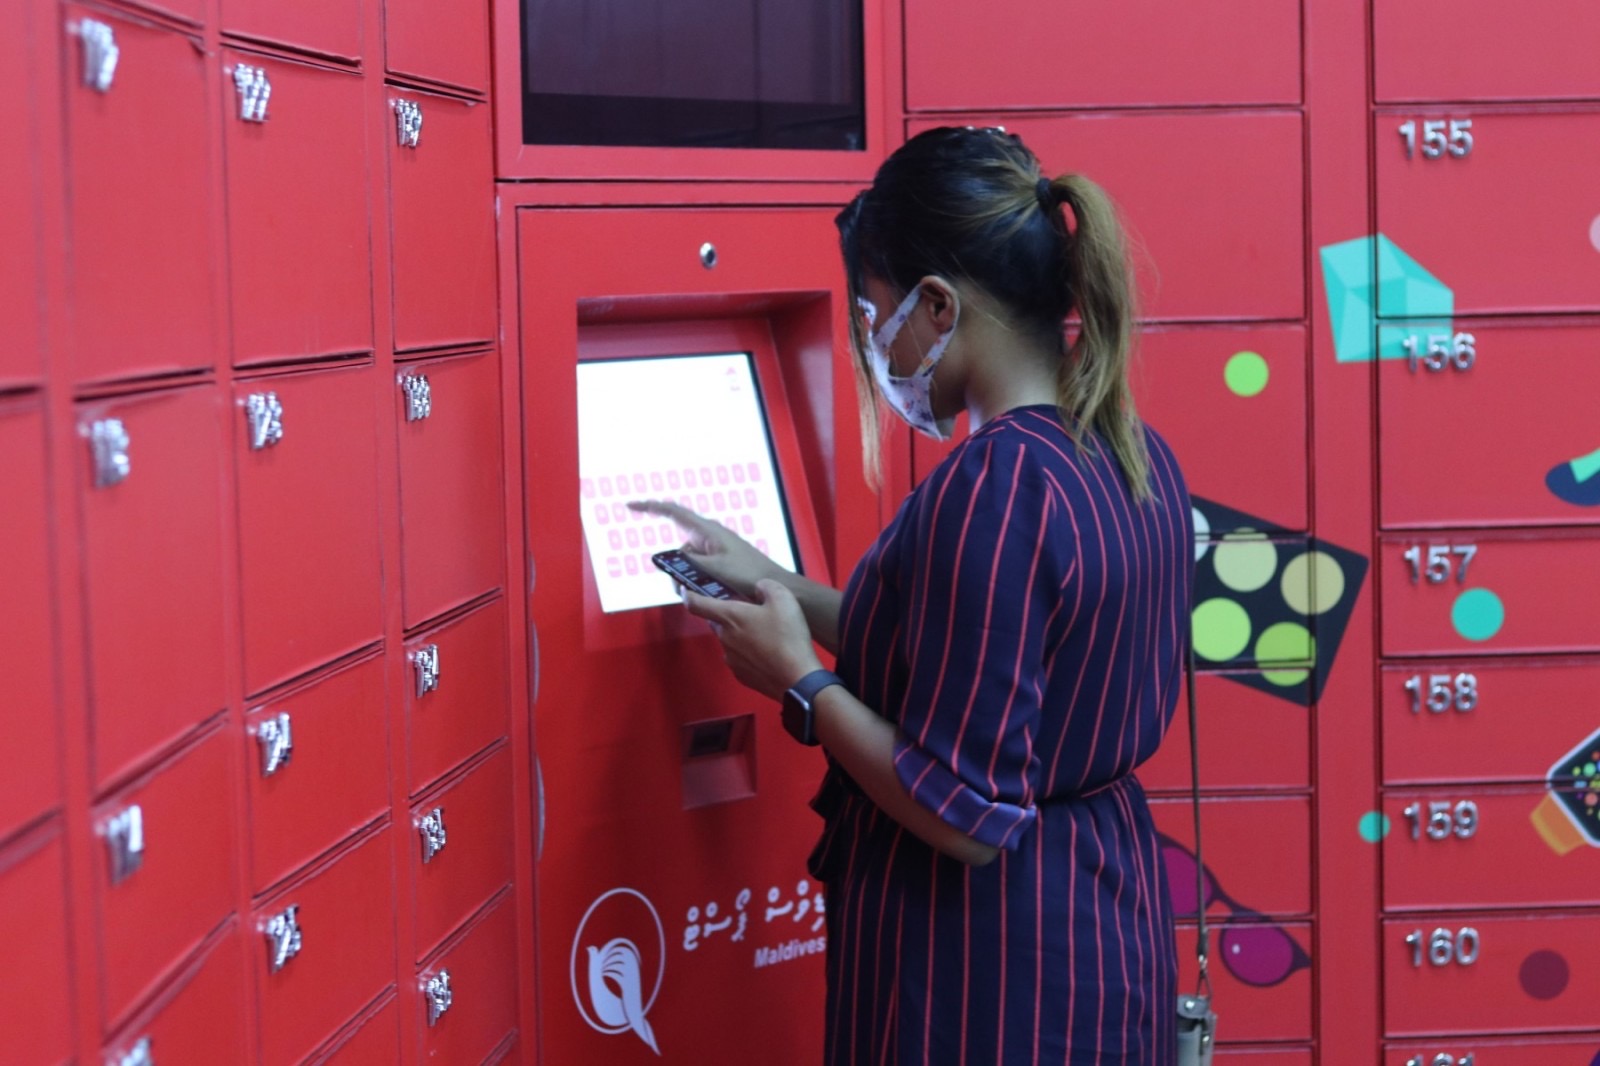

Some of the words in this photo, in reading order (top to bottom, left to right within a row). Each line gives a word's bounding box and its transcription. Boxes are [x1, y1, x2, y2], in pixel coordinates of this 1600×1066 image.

[1399, 119, 1474, 159] 155
[1404, 333, 1477, 372] 156
[1404, 544, 1478, 584] 157
[1404, 673, 1478, 713] 158
[1404, 800, 1478, 840] 159
[753, 936, 826, 968] Maldives
[1405, 927, 1480, 967] 160
